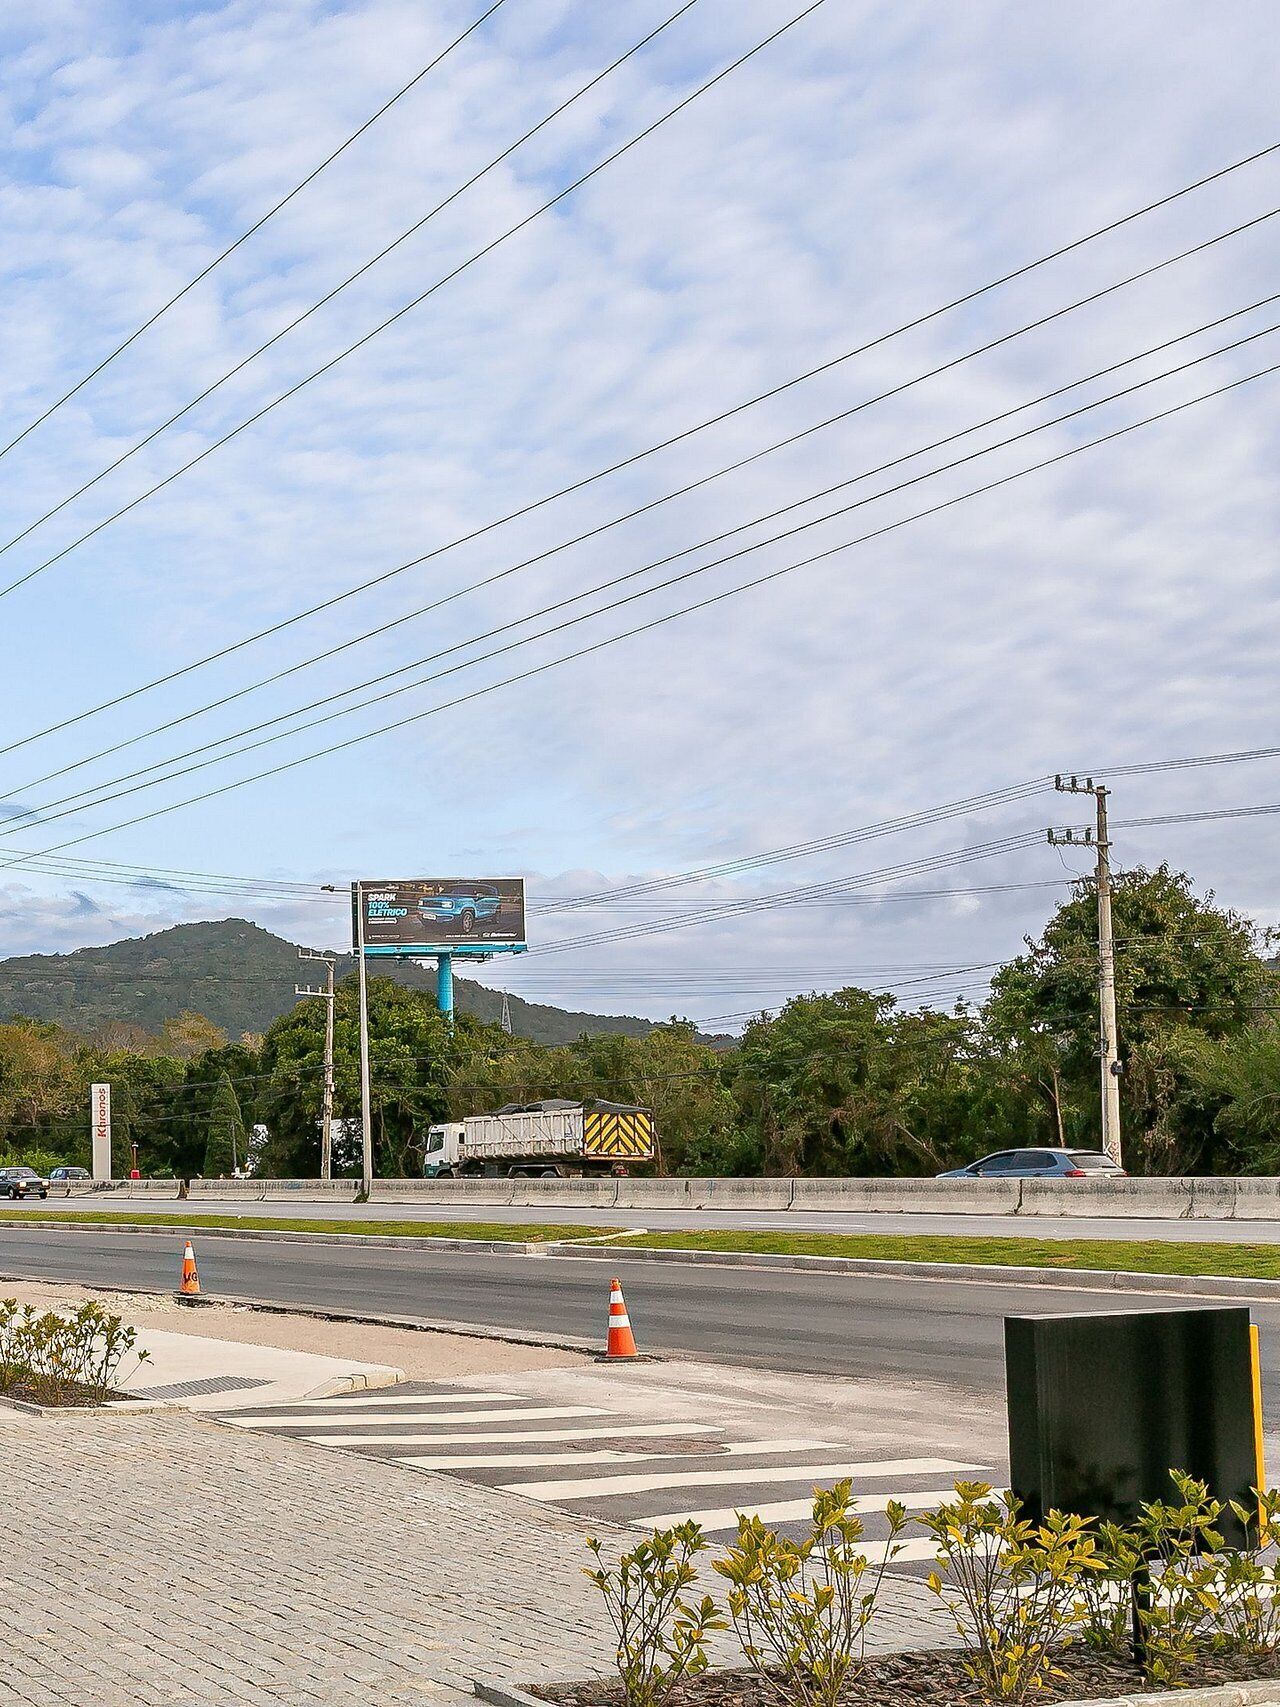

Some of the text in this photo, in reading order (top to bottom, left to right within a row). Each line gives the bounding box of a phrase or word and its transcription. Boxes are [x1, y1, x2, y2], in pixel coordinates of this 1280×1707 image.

[368, 893, 397, 901] SPARK
[368, 901, 390, 909] 100%
[97, 1087, 107, 1138] Khronos
